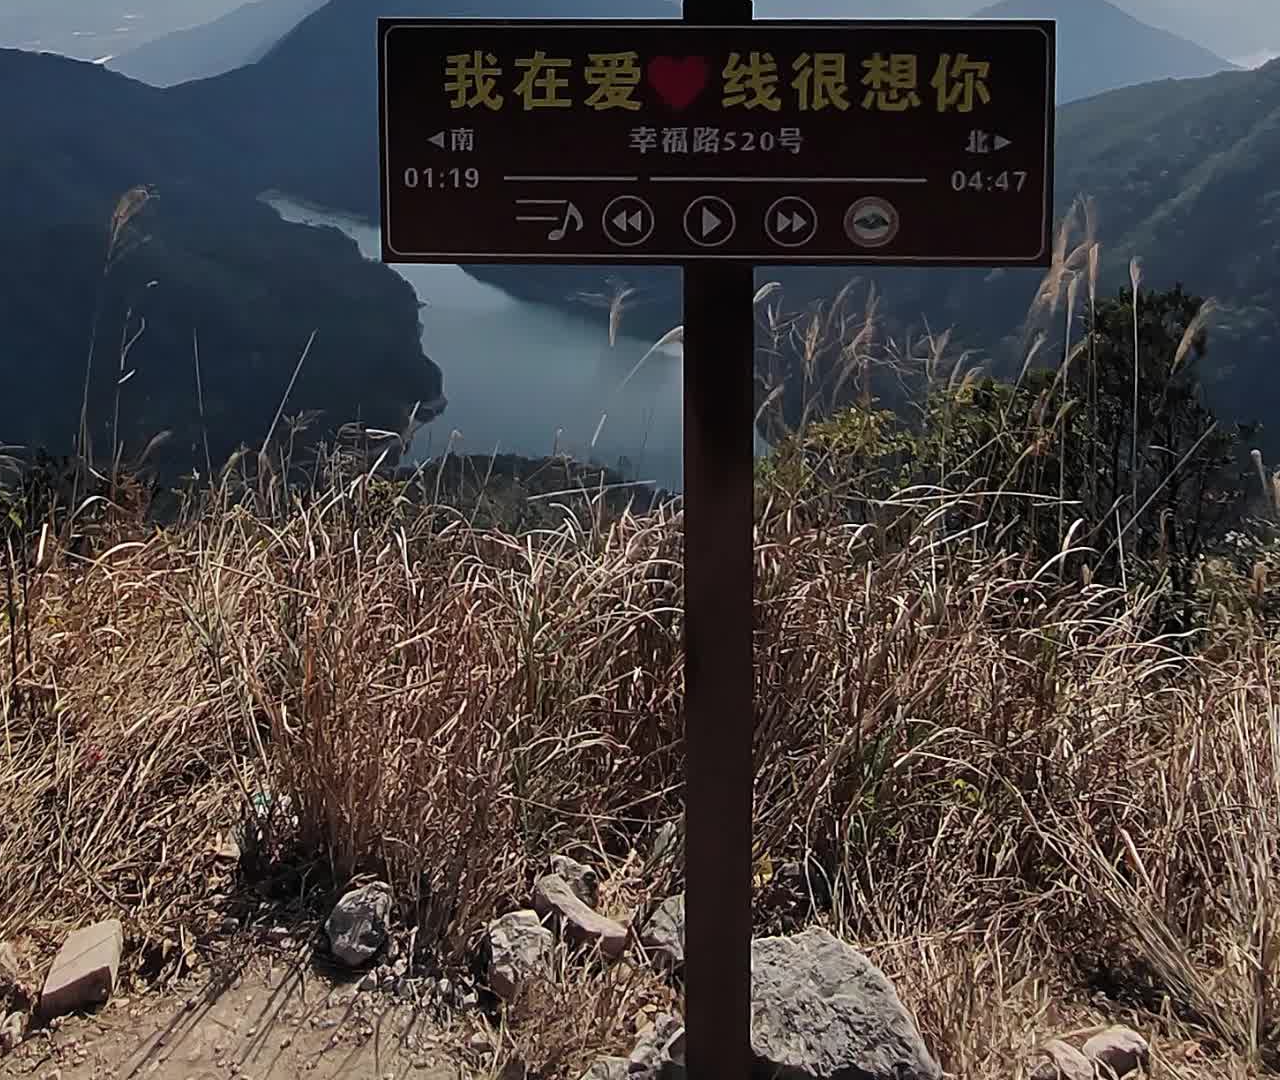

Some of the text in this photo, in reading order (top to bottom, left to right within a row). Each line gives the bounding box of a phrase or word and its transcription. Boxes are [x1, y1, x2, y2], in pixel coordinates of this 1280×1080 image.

[451, 128, 473, 152] 南
[629, 127, 803, 154] 幸福路520号
[965, 130, 988, 153] 北
[404, 167, 479, 189] 01:19
[951, 170, 1027, 192] 04:47
